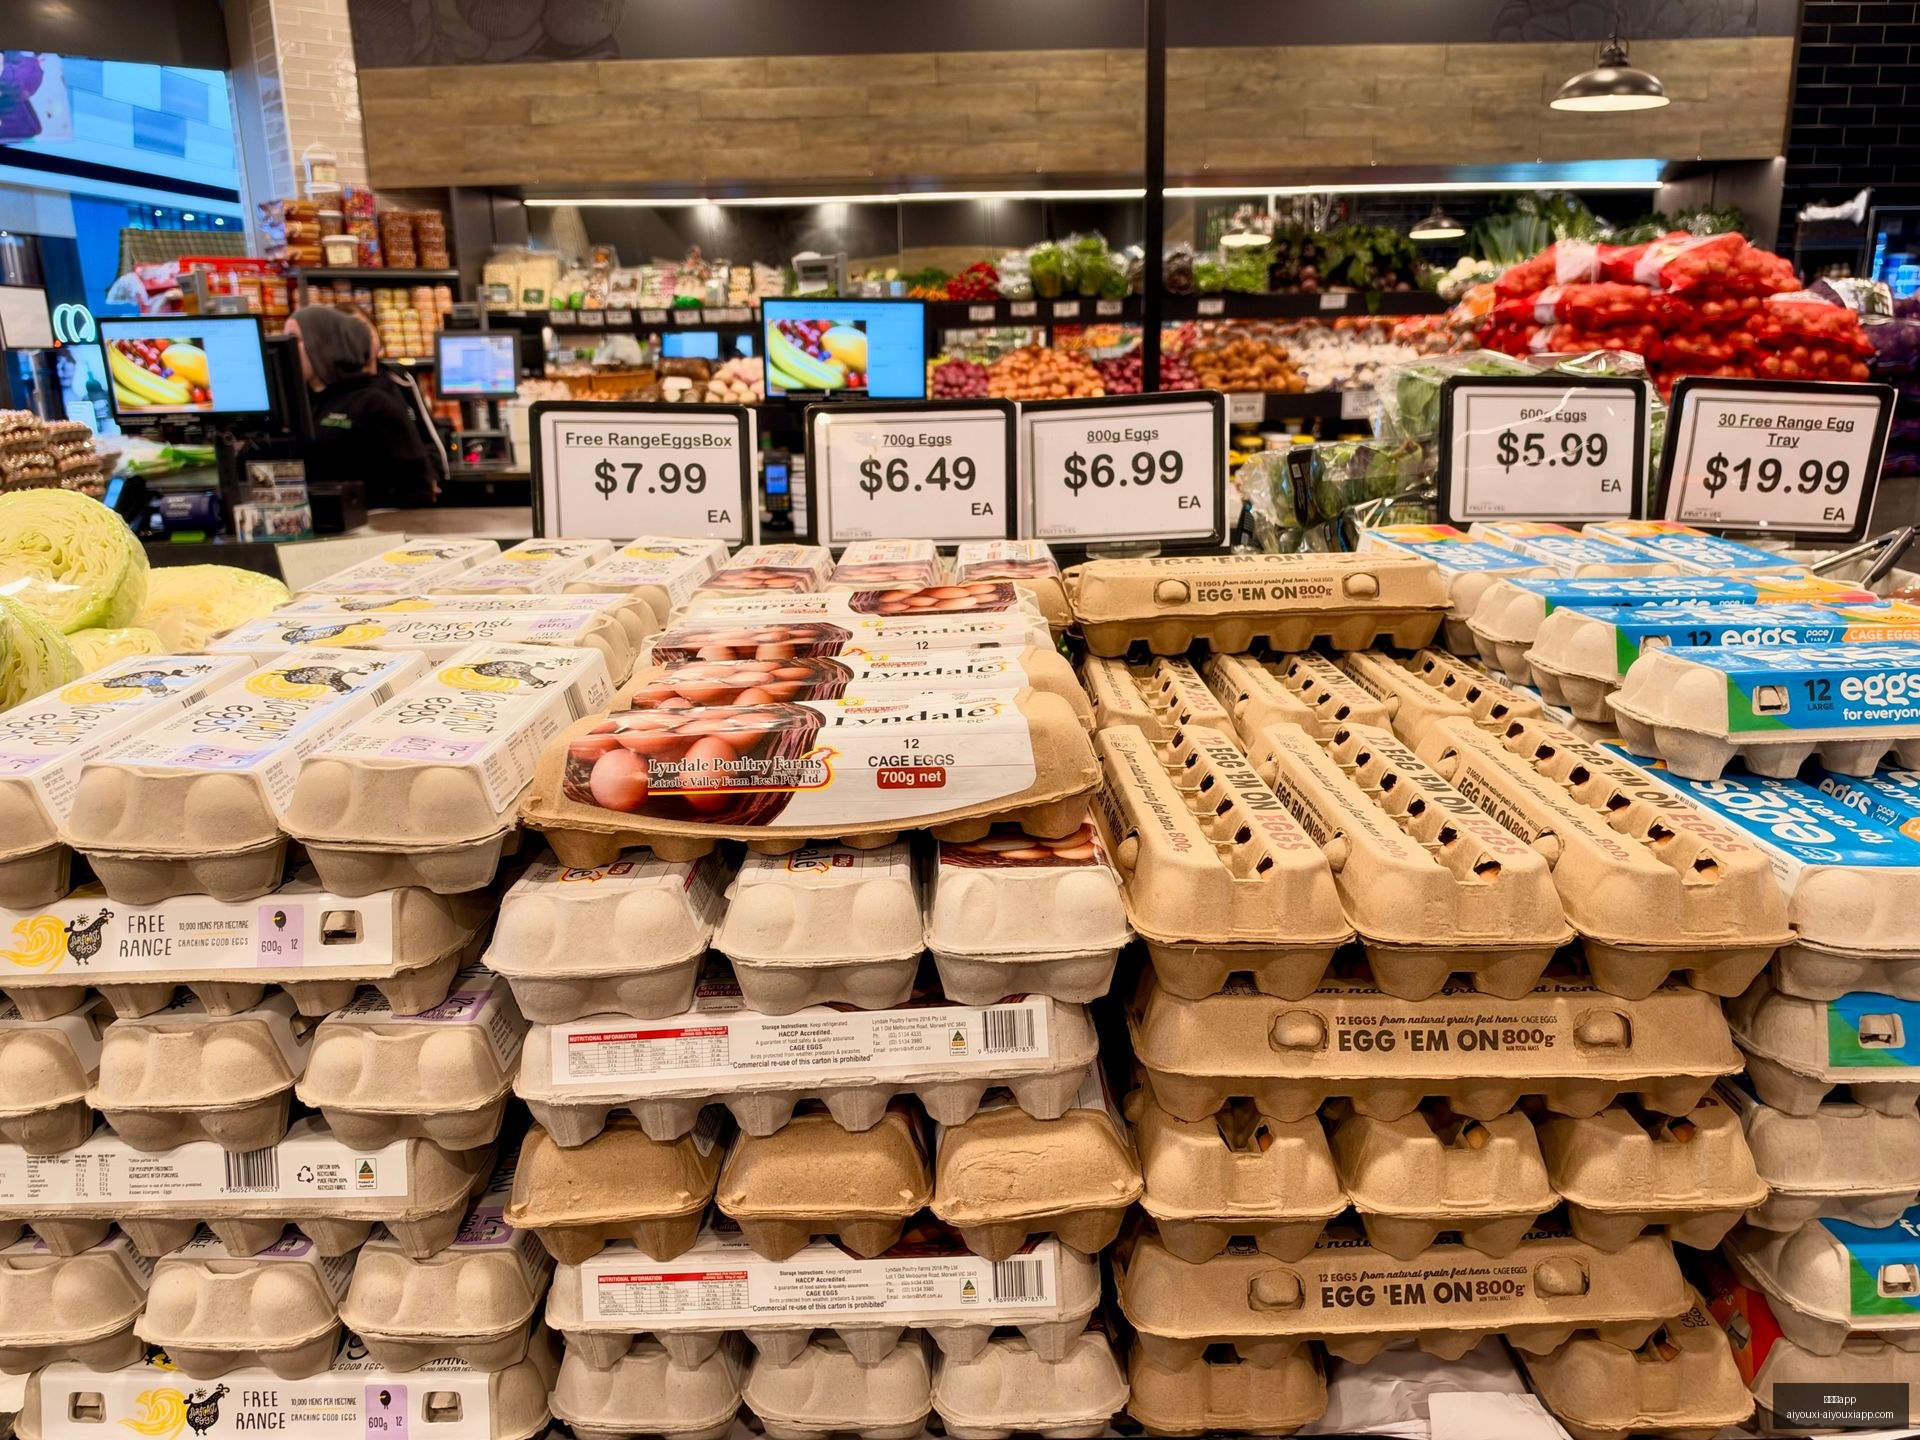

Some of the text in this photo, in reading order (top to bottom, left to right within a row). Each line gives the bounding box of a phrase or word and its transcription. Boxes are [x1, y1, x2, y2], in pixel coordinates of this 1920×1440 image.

[1520, 409, 1587, 423] 600g Eggs
[1718, 413, 1855, 433] 30 Free Range Egg
[565, 432, 732, 449] Free RangeEggsBox
[882, 433, 952, 448] 700g Eggs
[1087, 428, 1159, 444] 800g Eggs
[1767, 434, 1800, 449] Tray
[1497, 429, 1608, 474] $5.99
[595, 459, 707, 500] $7.99
[859, 454, 977, 500] $6.49
[1064, 450, 1183, 497] $6.99
[1703, 452, 1850, 498] $19.99
[1601, 479, 1622, 492] EA
[971, 503, 993, 517] EA
[1178, 496, 1201, 509] EA
[708, 510, 731, 524] EA
[1823, 507, 1845, 521] EA
[1197, 585, 1332, 602] EGG 'EM ON 800g
[877, 624, 993, 637] Lyndale
[1687, 631, 1711, 646] 12
[1720, 628, 1829, 646] eggs pace
[1850, 629, 1920, 641] CAGE EGGS
[916, 641, 929, 650] 12
[861, 664, 994, 680] Lyndale
[1803, 672, 1920, 707] 12 eggs
[1807, 703, 1834, 712] LARGE
[1843, 707, 1920, 721] for everyon
[835, 706, 986, 727] Lyndale
[903, 738, 919, 750] 12
[868, 754, 955, 768] CAGE EGGS
[1205, 746, 1246, 770] EGG
[649, 757, 822, 776] Lyndale Poultry Farms
[648, 773, 821, 789] Latrobe Valley Farm Fresh Ltd.
[881, 770, 941, 786] 700g net
[1240, 792, 1282, 812] ON
[1275, 783, 1293, 810] EGG
[1380, 747, 1529, 857] EGG ON EGGS
[1559, 741, 1749, 853] EGG ON EGGS
[1457, 777, 1515, 833] EGG ON
[1690, 778, 1836, 843] eggs
[1254, 814, 1312, 851] EGGS
[128, 914, 165, 934] FREE
[178, 920, 249, 931] 10,000 HENS PER HECTARE
[119, 938, 172, 957] RANGE
[178, 938, 249, 948] CRACKING GOOD EGGS
[261, 938, 299, 955] 600g 12
[1335, 1014, 1558, 1027] 12 EGGS from natural grain fed hens CAGE EGGS
[569, 1033, 638, 1043] NUTRITIONAL INFORMATION
[778, 1030, 799, 1038] HACCP
[1338, 1028, 1556, 1052] EGG 'EM ON 800g
[806, 1043, 823, 1051] EGGS
[630, 1274, 663, 1282] INFORMATION
[1318, 1266, 1527, 1282] 12 EGGS from natural grain fed hens CAGE EGGS
[1321, 1280, 1525, 1308] EGG 'EM ON 800g
[788, 1303, 807, 1311] re-use
[808, 1302, 814, 1310] of
[815, 1302, 826, 1310] this
[827, 1301, 847, 1309] carton
[243, 1390, 278, 1408] FREE
[291, 1397, 357, 1406] 10,000 HENS PER HECTARE
[235, 1412, 286, 1430] RANGE
[290, 1413, 357, 1422] CRACKING GOOD EGGS
[368, 1415, 403, 1431] 600g 12
